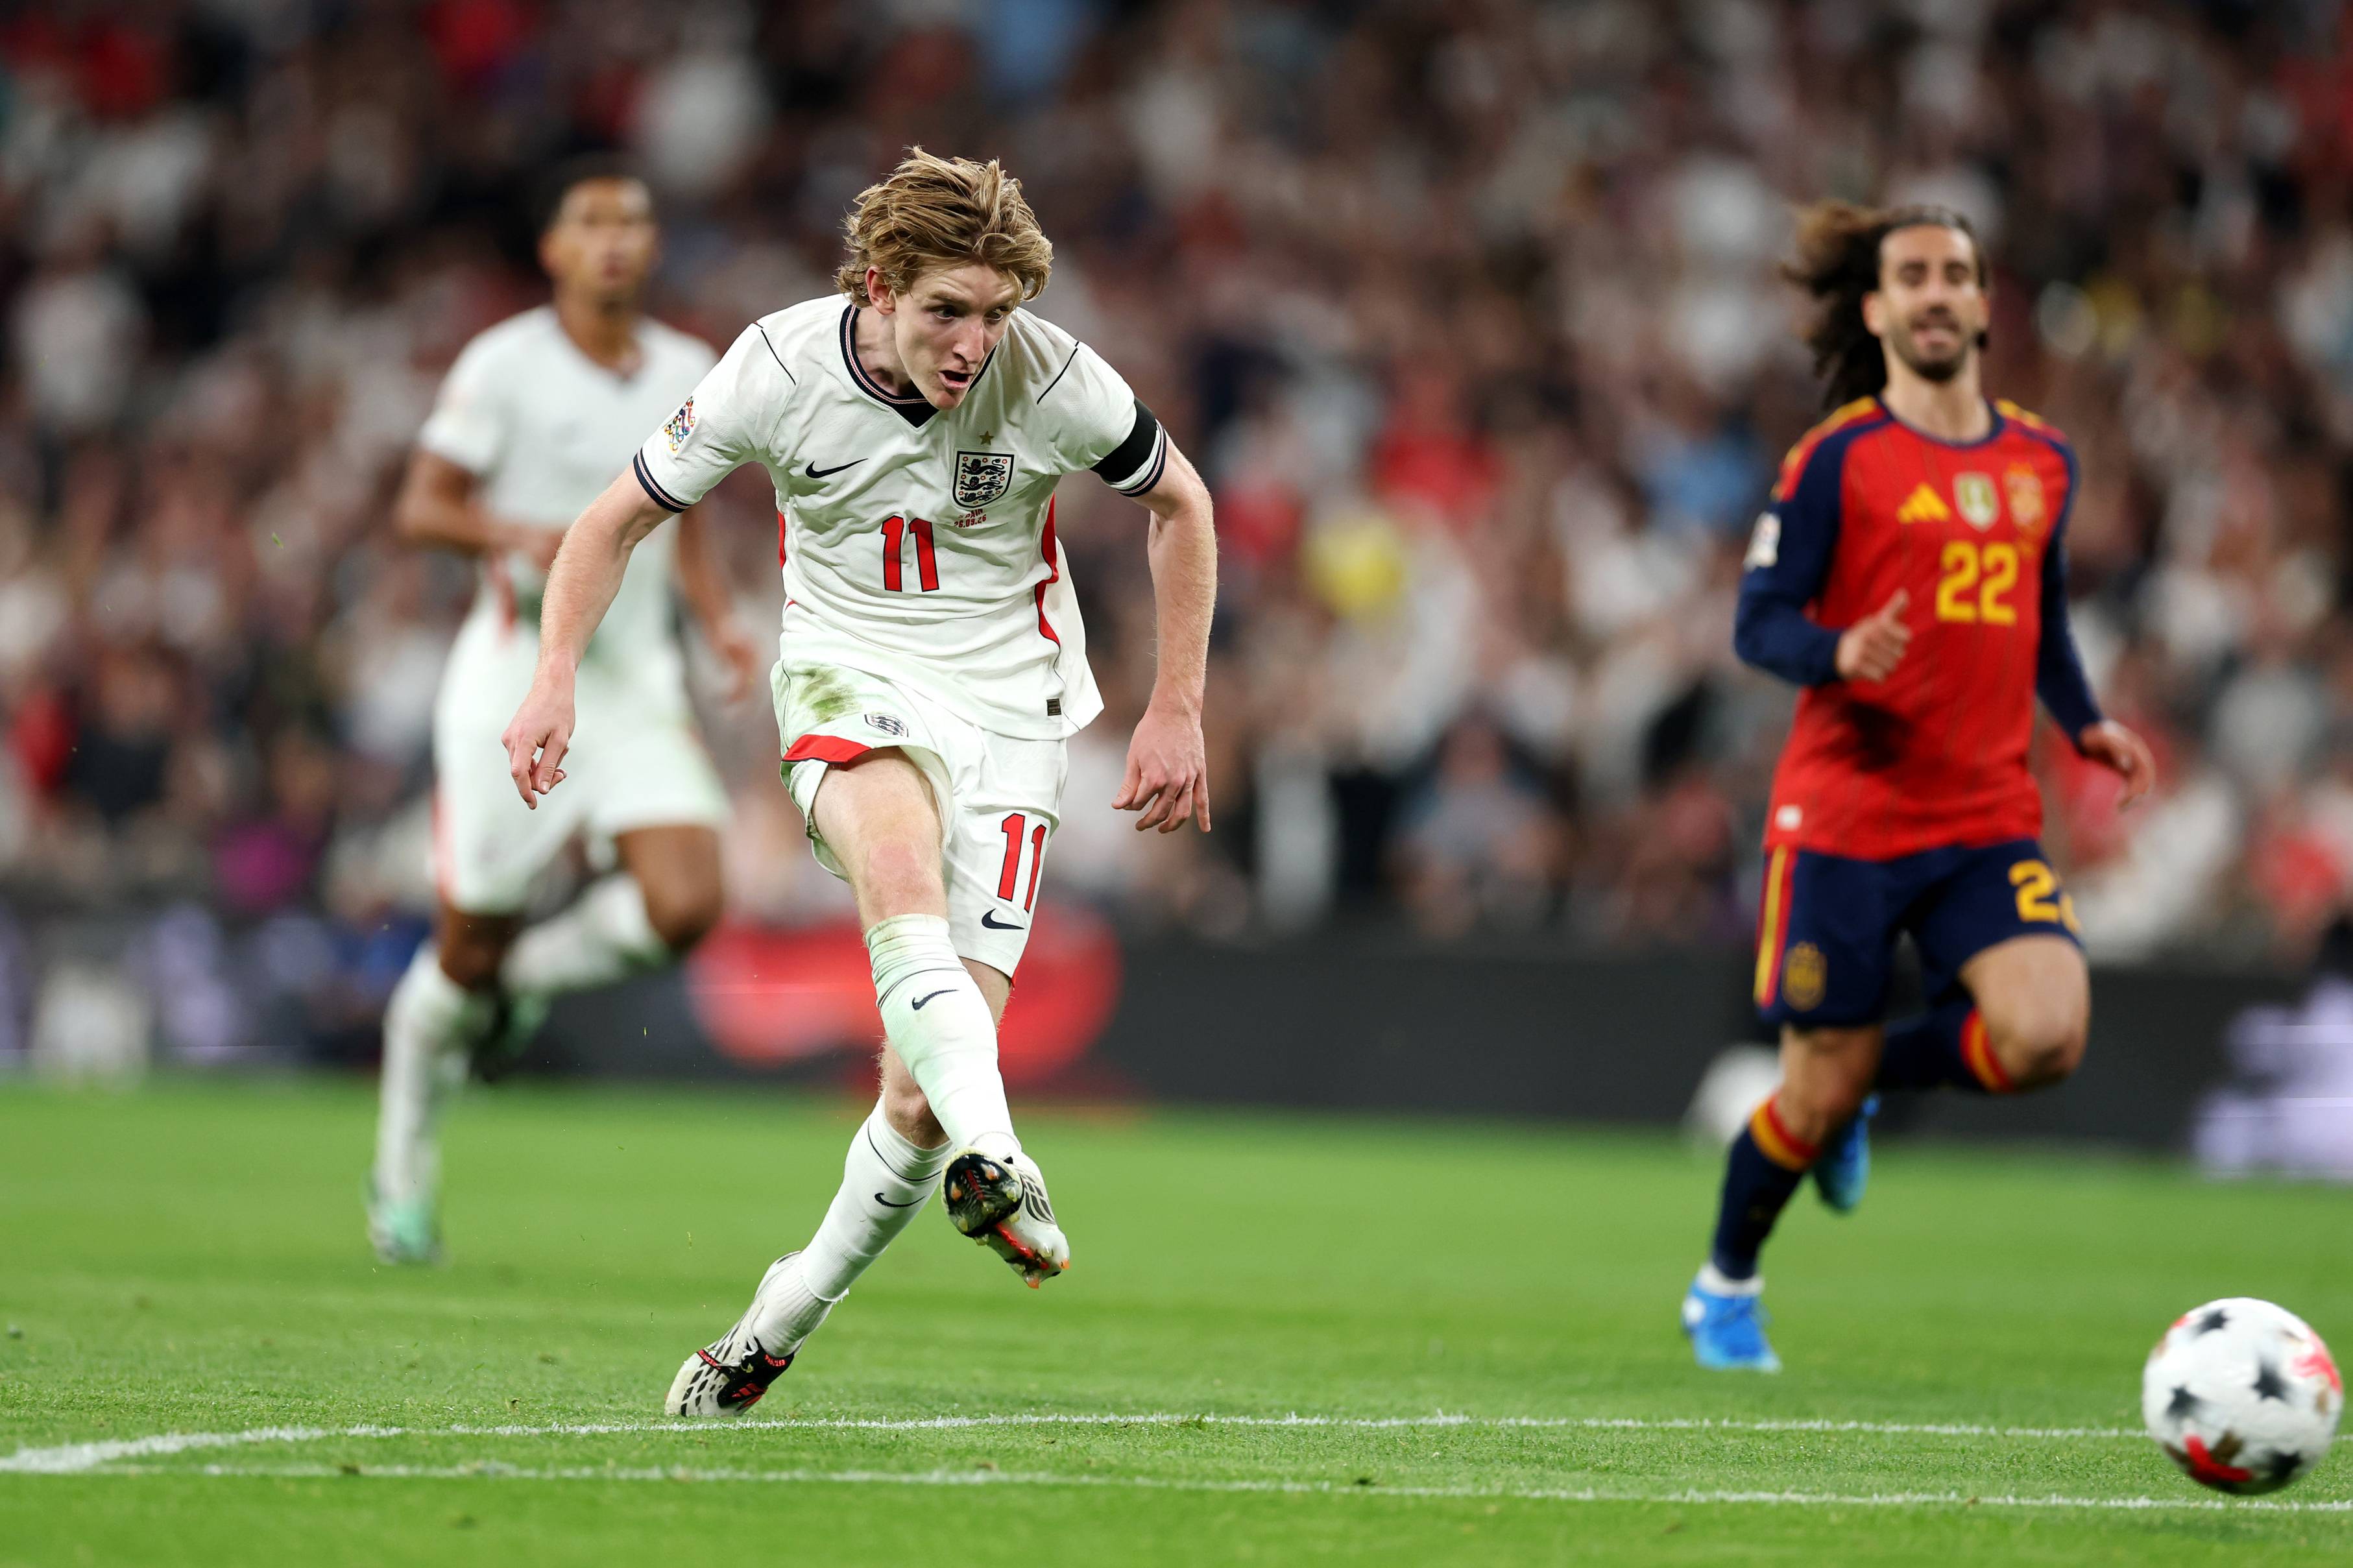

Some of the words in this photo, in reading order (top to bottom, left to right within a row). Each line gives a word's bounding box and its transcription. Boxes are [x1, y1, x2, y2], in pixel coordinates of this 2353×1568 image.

[881, 515, 939, 592] 11
[1935, 540, 2018, 626] 22
[997, 813, 1046, 913] 11
